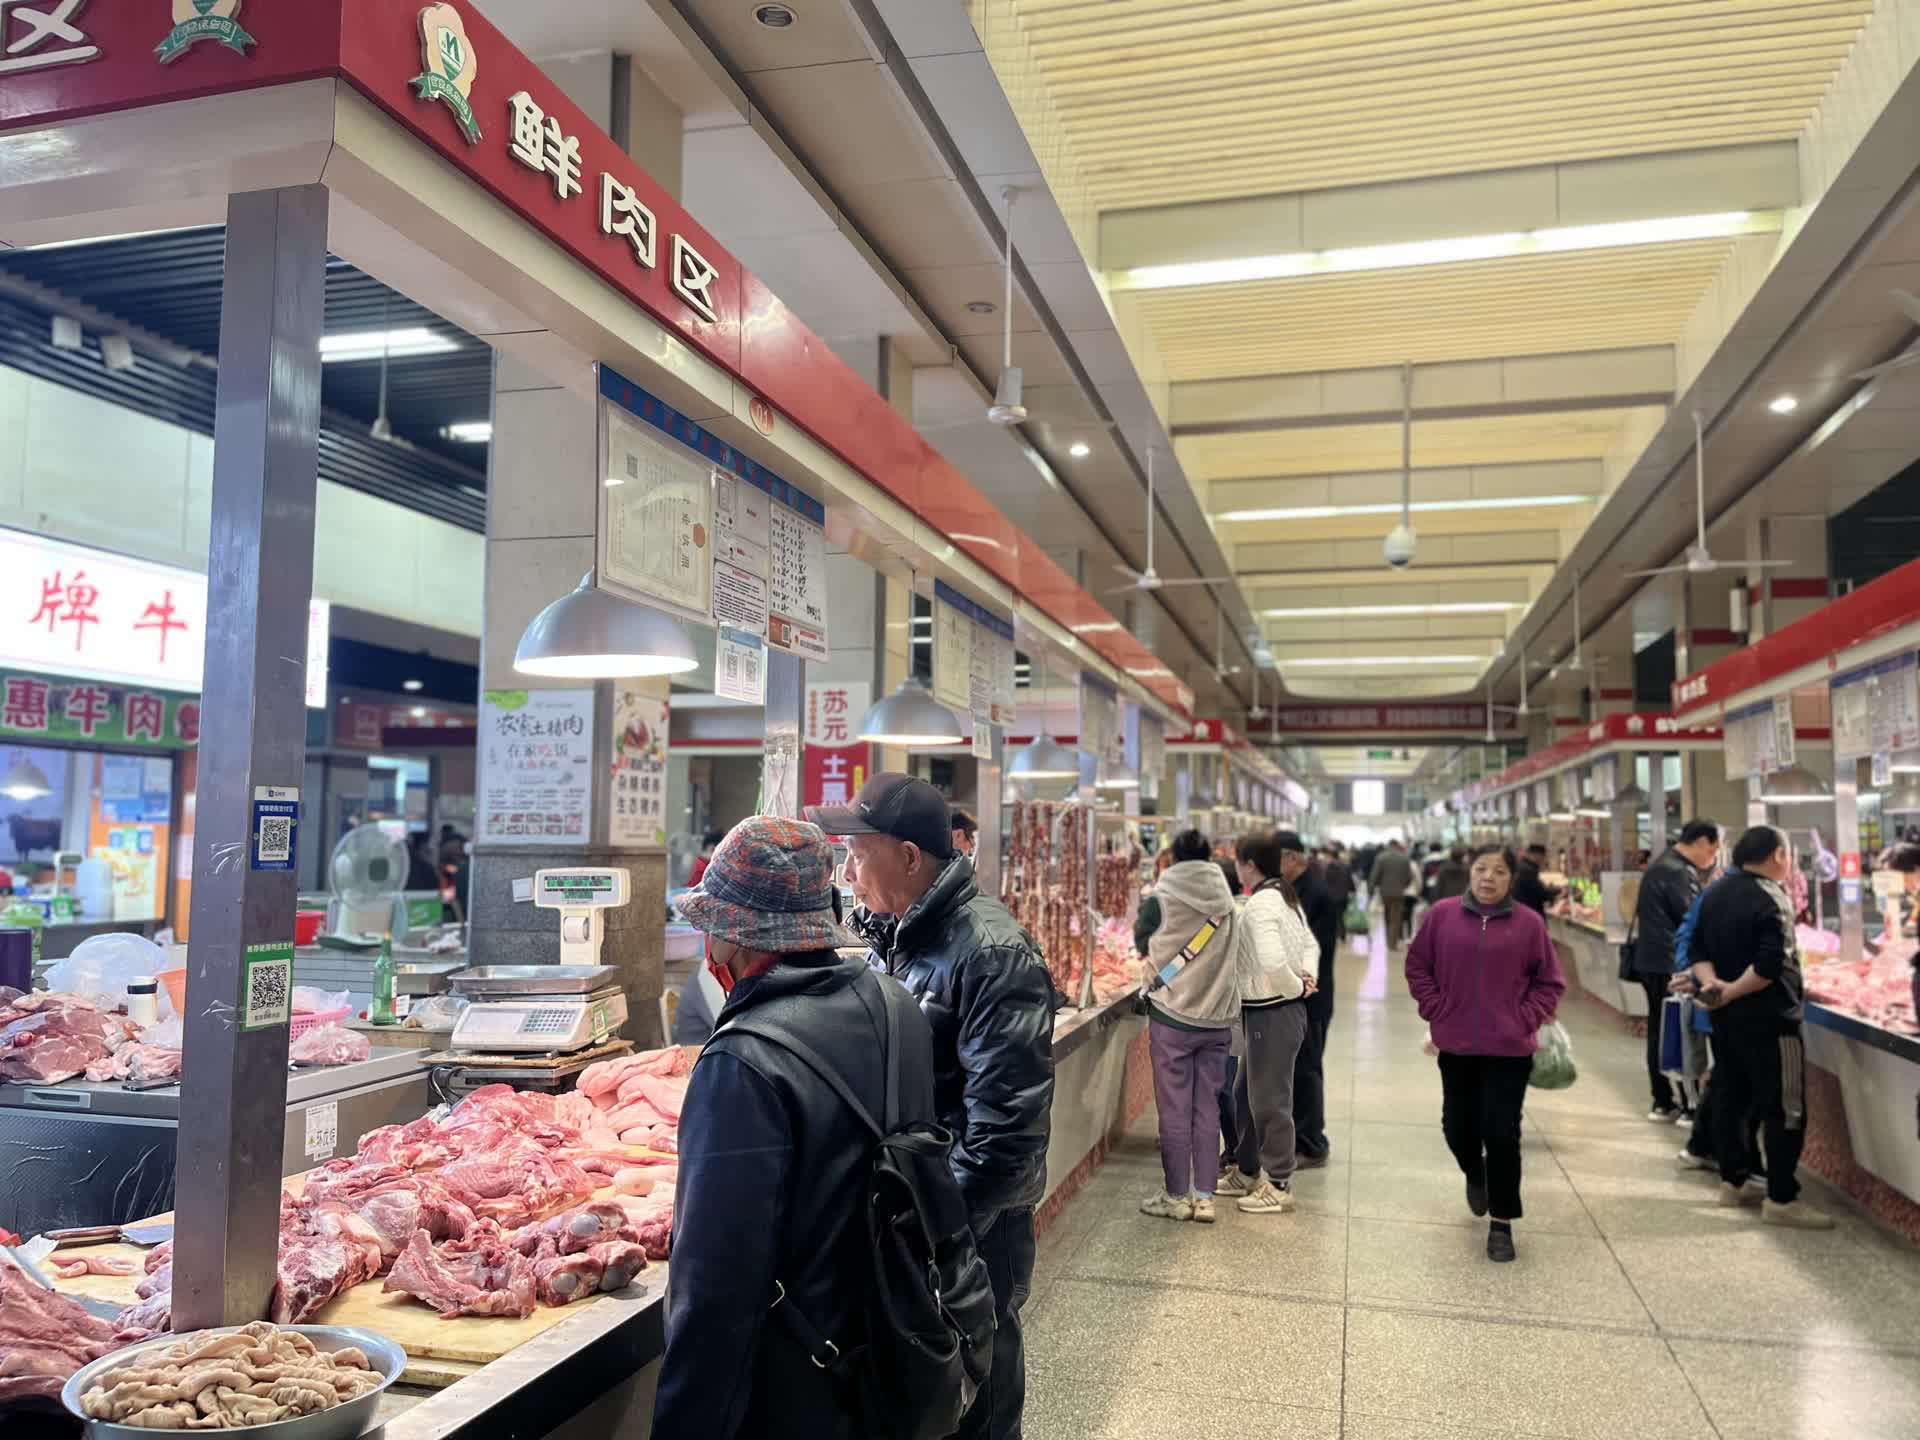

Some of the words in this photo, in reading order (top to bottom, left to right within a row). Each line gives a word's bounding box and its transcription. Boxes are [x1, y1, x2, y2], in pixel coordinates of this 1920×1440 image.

[509, 91, 719, 322] 鲜肉区
[29, 570, 188, 662] 牌牛
[5, 680, 164, 738] 惠牛肉
[823, 689, 848, 741] 苏元
